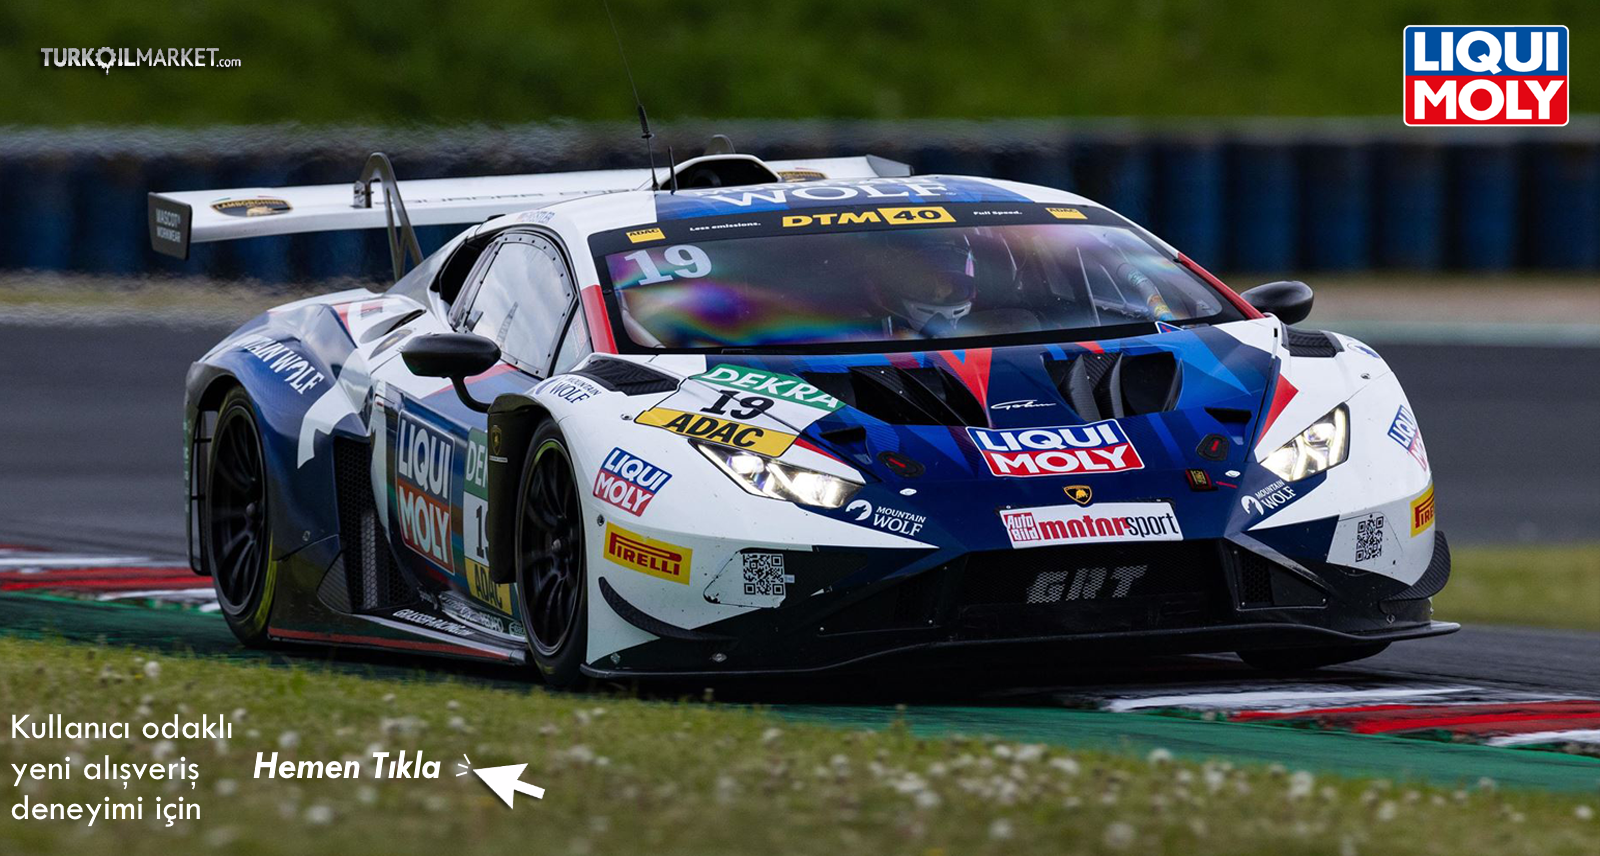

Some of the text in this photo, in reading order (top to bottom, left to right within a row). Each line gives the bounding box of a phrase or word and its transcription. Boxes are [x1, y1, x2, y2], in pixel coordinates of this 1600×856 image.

[702, 183, 949, 207] WOLF
[782, 209, 942, 228] DTM 40
[629, 228, 660, 237] ADAC
[624, 244, 713, 286] 19
[549, 382, 591, 404] WOLF
[701, 366, 839, 409] DEKRA
[700, 389, 775, 420] 19
[662, 413, 764, 448] ADAC
[975, 424, 1119, 451] LIQUI
[399, 419, 451, 499] LIQUI
[603, 449, 670, 491] LIQUI
[990, 445, 1129, 473] MOLY
[596, 471, 653, 515] MOLY
[1254, 479, 1286, 500] MOUNTAIN
[1260, 485, 1297, 509] WOLF
[399, 485, 449, 565] MOLY
[873, 513, 923, 537] WOLF
[875, 506, 927, 523] MOUNTAIN
[1006, 512, 1035, 530] Auto
[1010, 527, 1040, 542] Bild
[609, 531, 683, 576] PIRELLI
[1026, 565, 1148, 604] GRT
